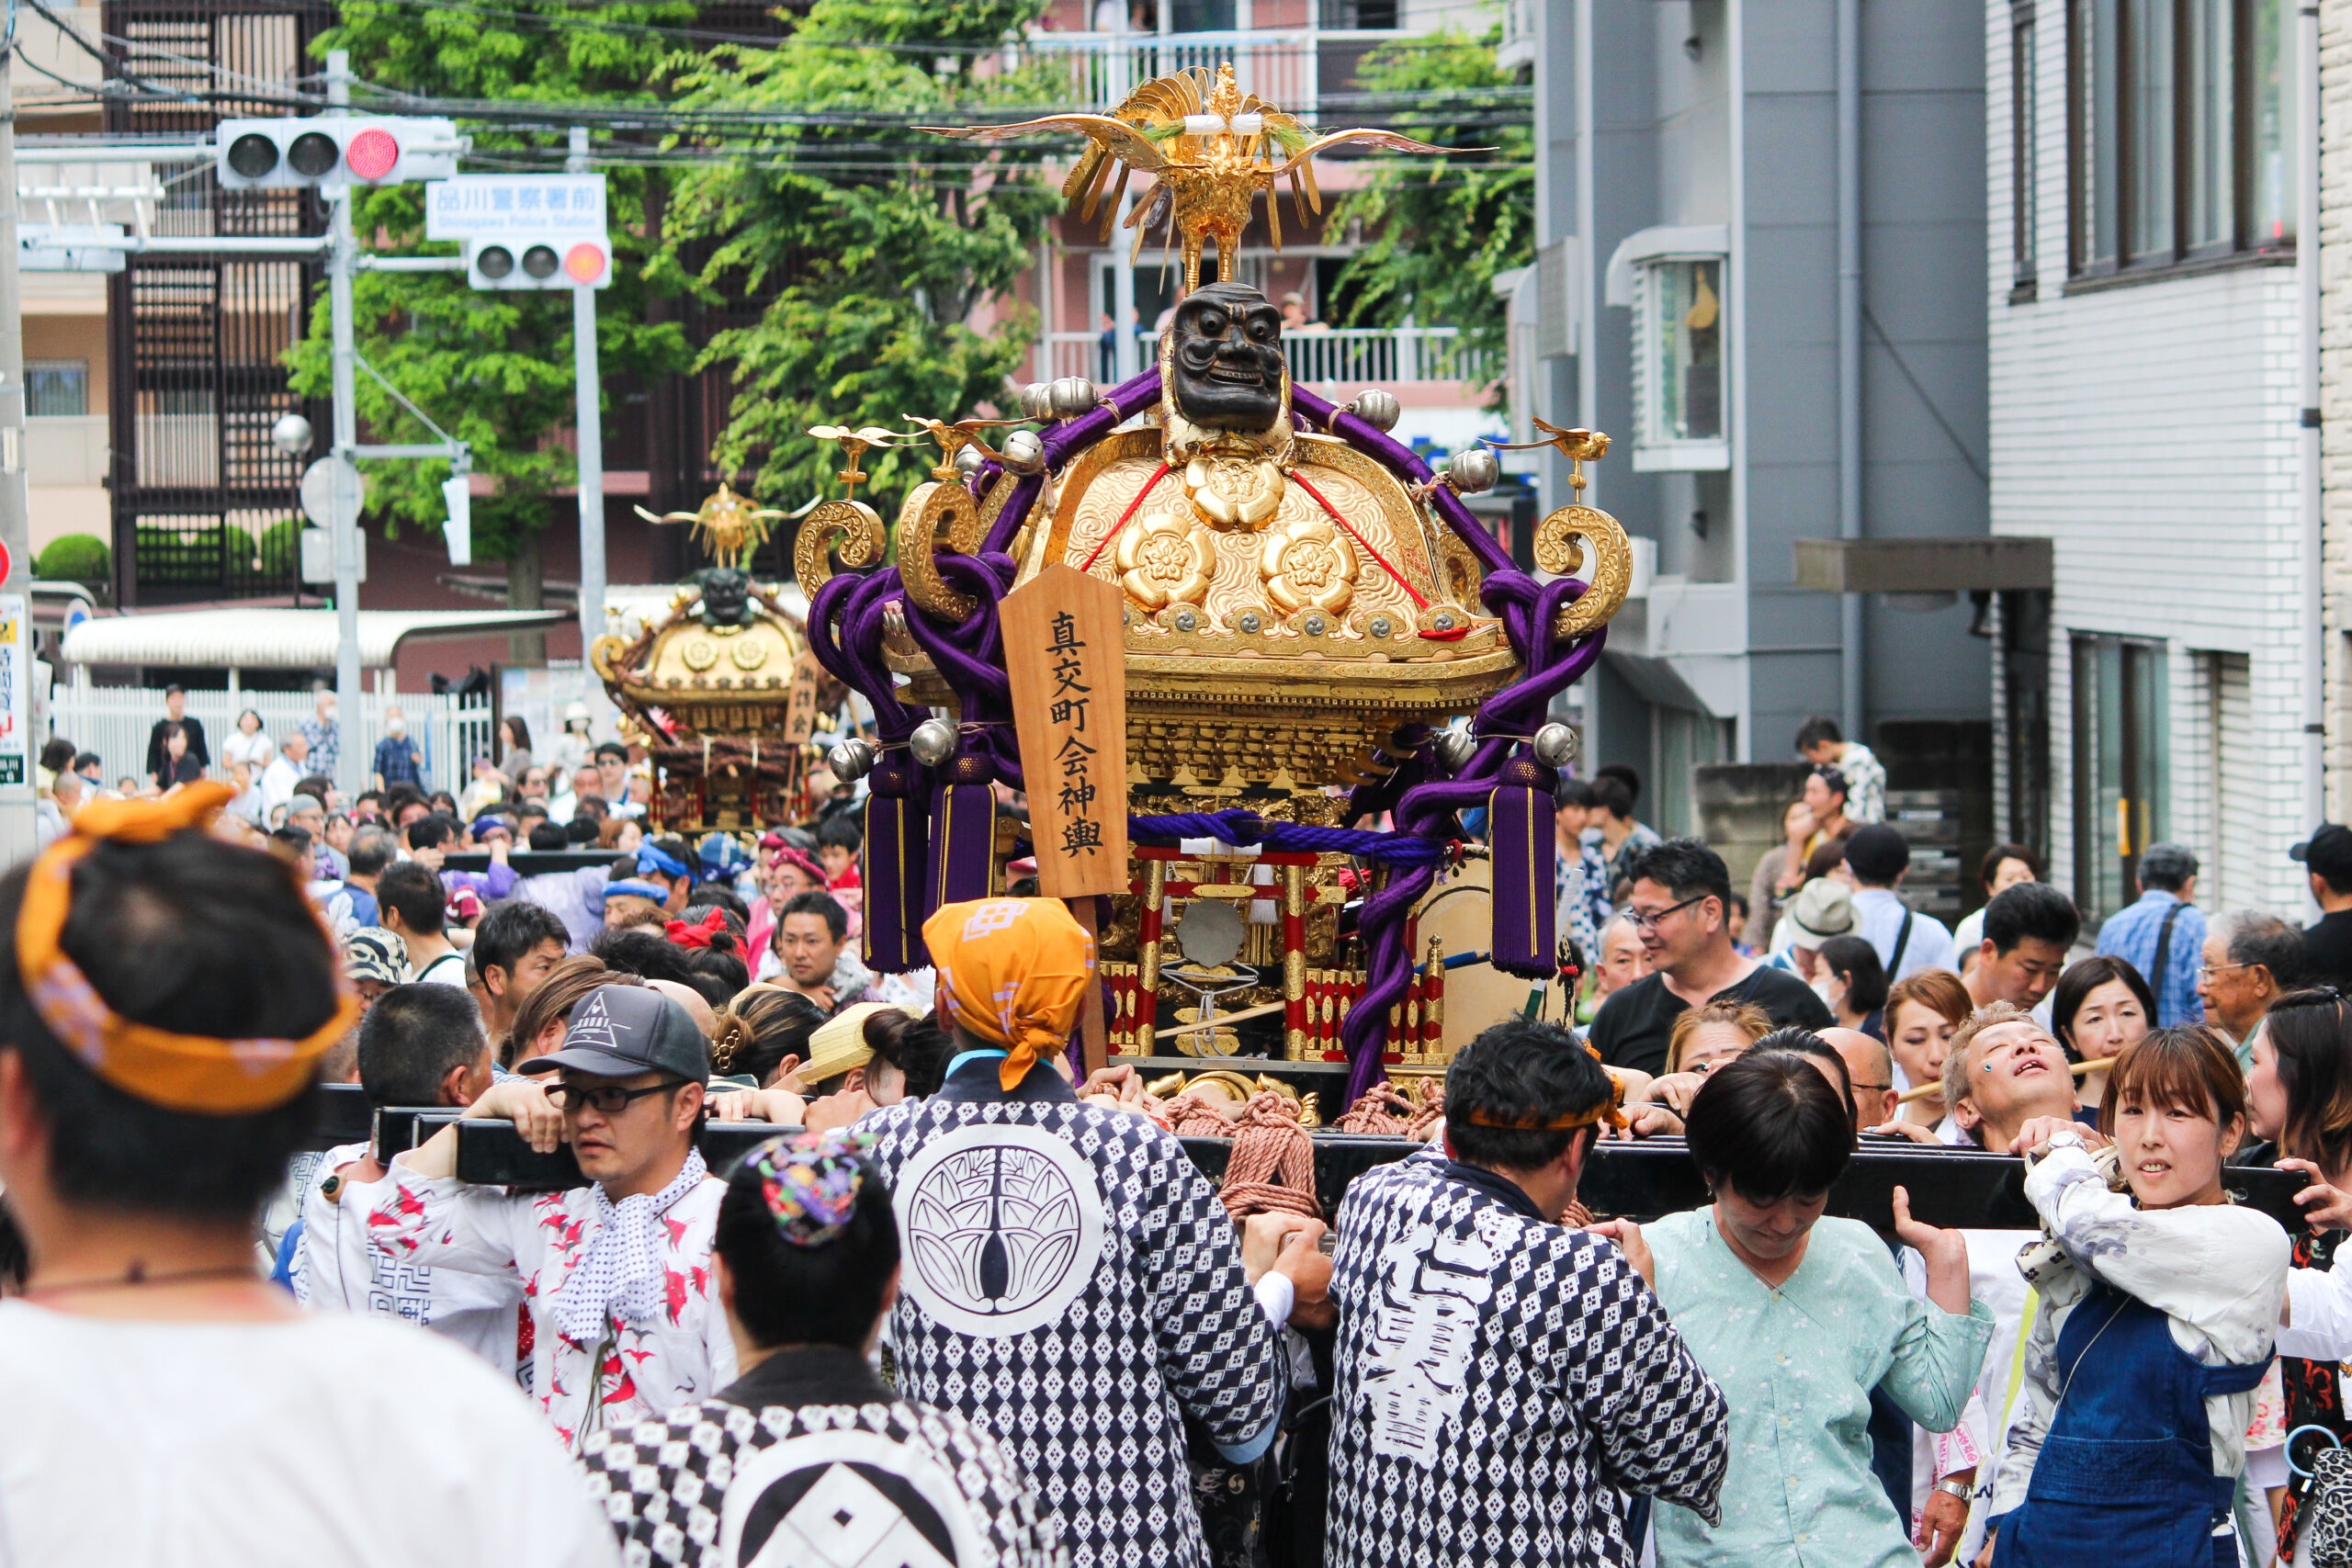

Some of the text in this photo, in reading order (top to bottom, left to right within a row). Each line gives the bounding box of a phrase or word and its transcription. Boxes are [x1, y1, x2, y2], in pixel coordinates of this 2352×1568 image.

[436, 186, 596, 210] 品川警察署前
[509, 214, 548, 227] Police
[552, 214, 596, 227] Station
[1044, 610, 1104, 859] 真交町会神輿
